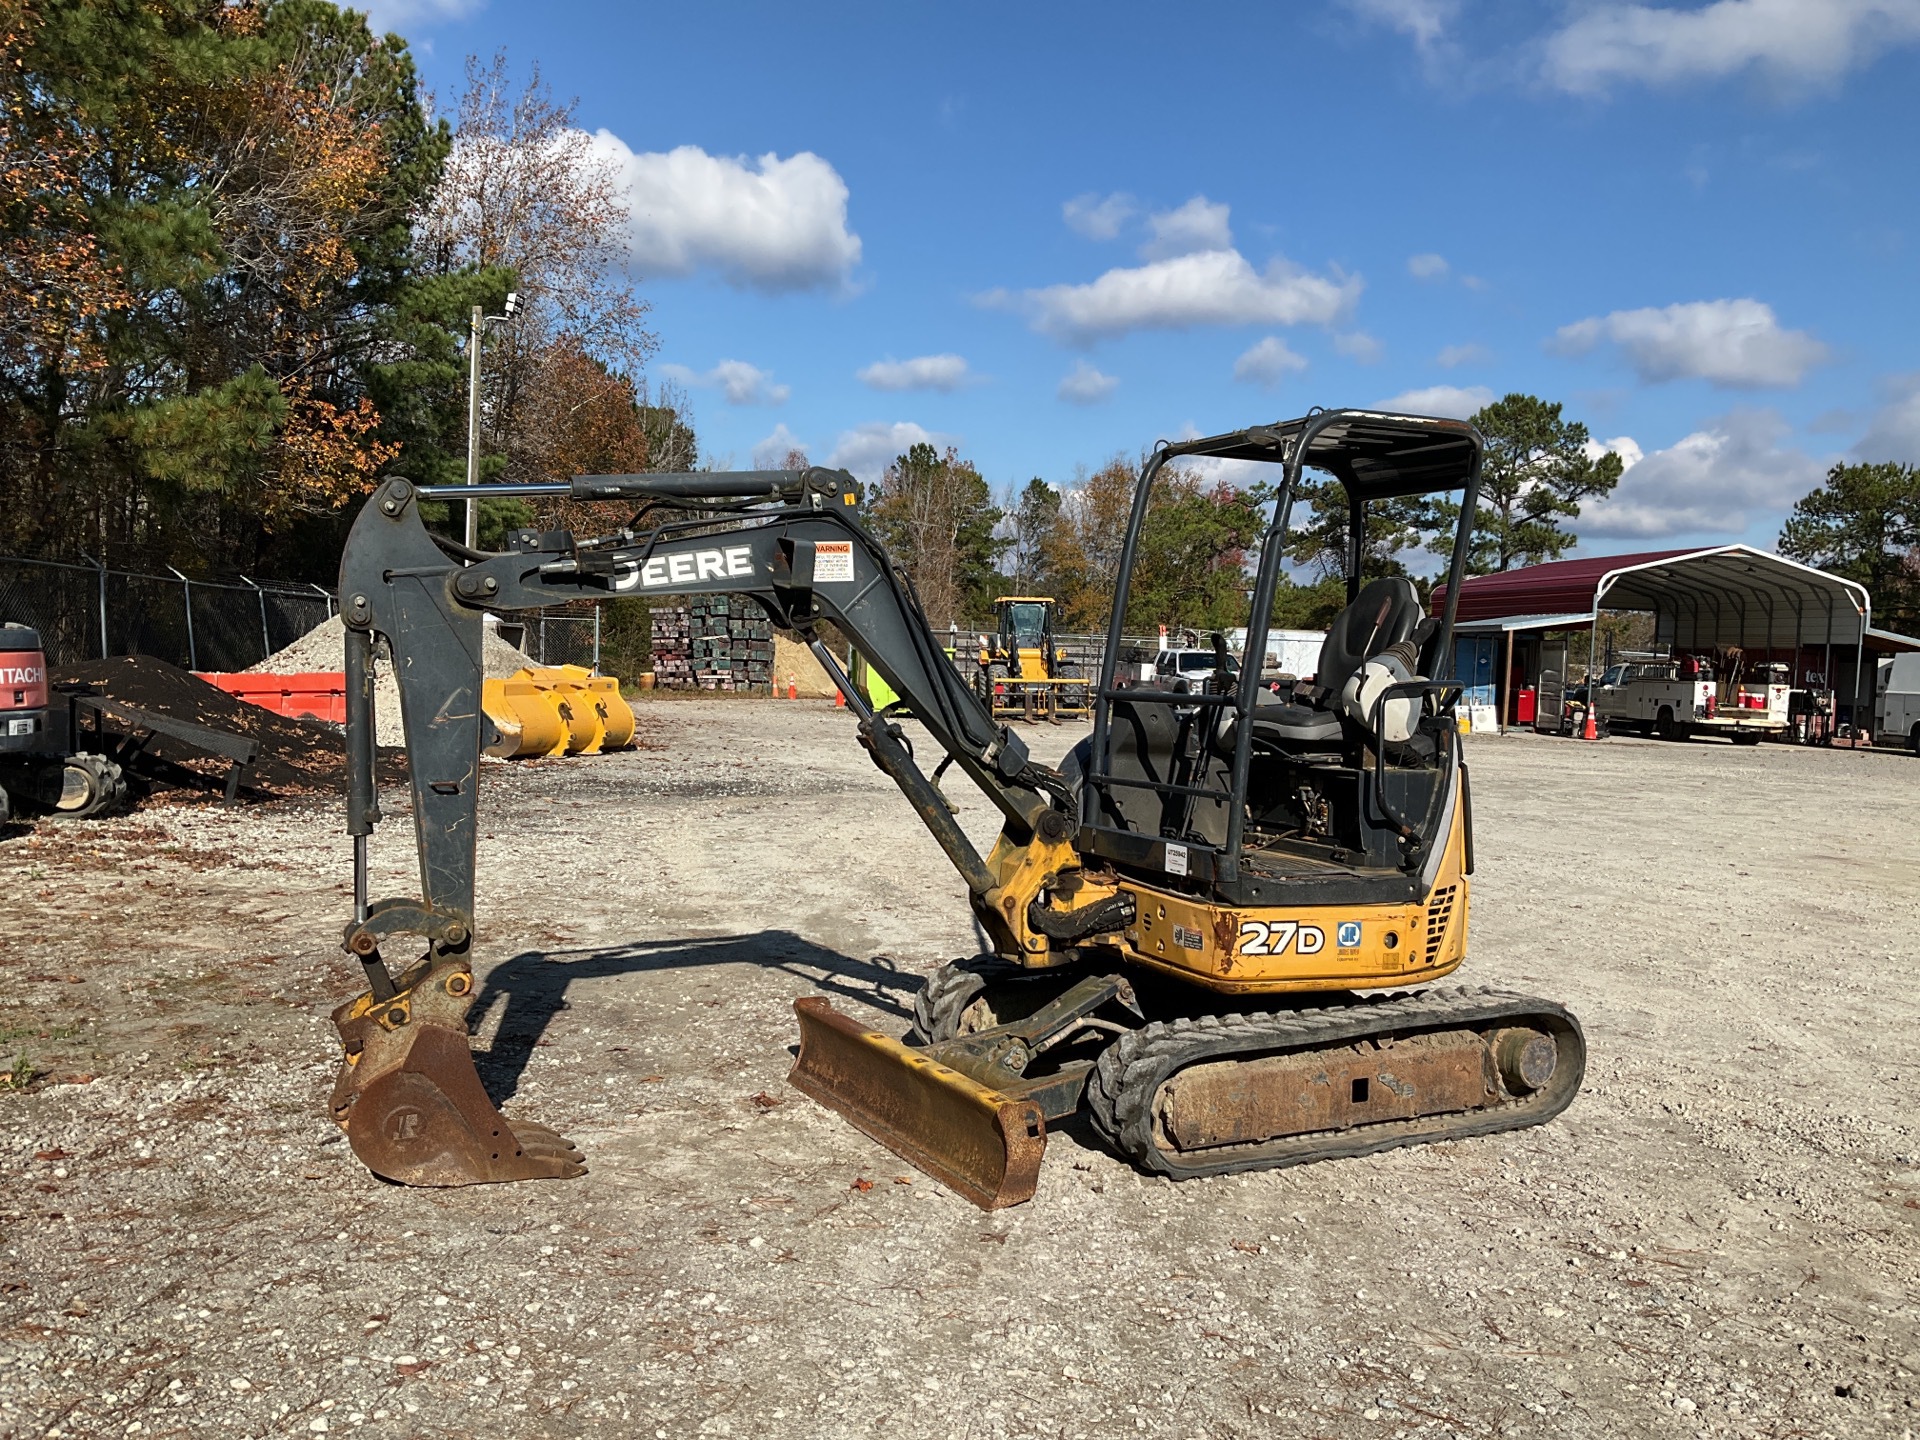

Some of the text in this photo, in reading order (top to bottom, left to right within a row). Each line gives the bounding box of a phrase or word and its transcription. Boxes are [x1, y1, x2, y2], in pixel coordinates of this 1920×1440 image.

[612, 545, 753, 590] DEERE
[0, 666, 43, 684] ITACHI
[1240, 920, 1325, 955] 27D
